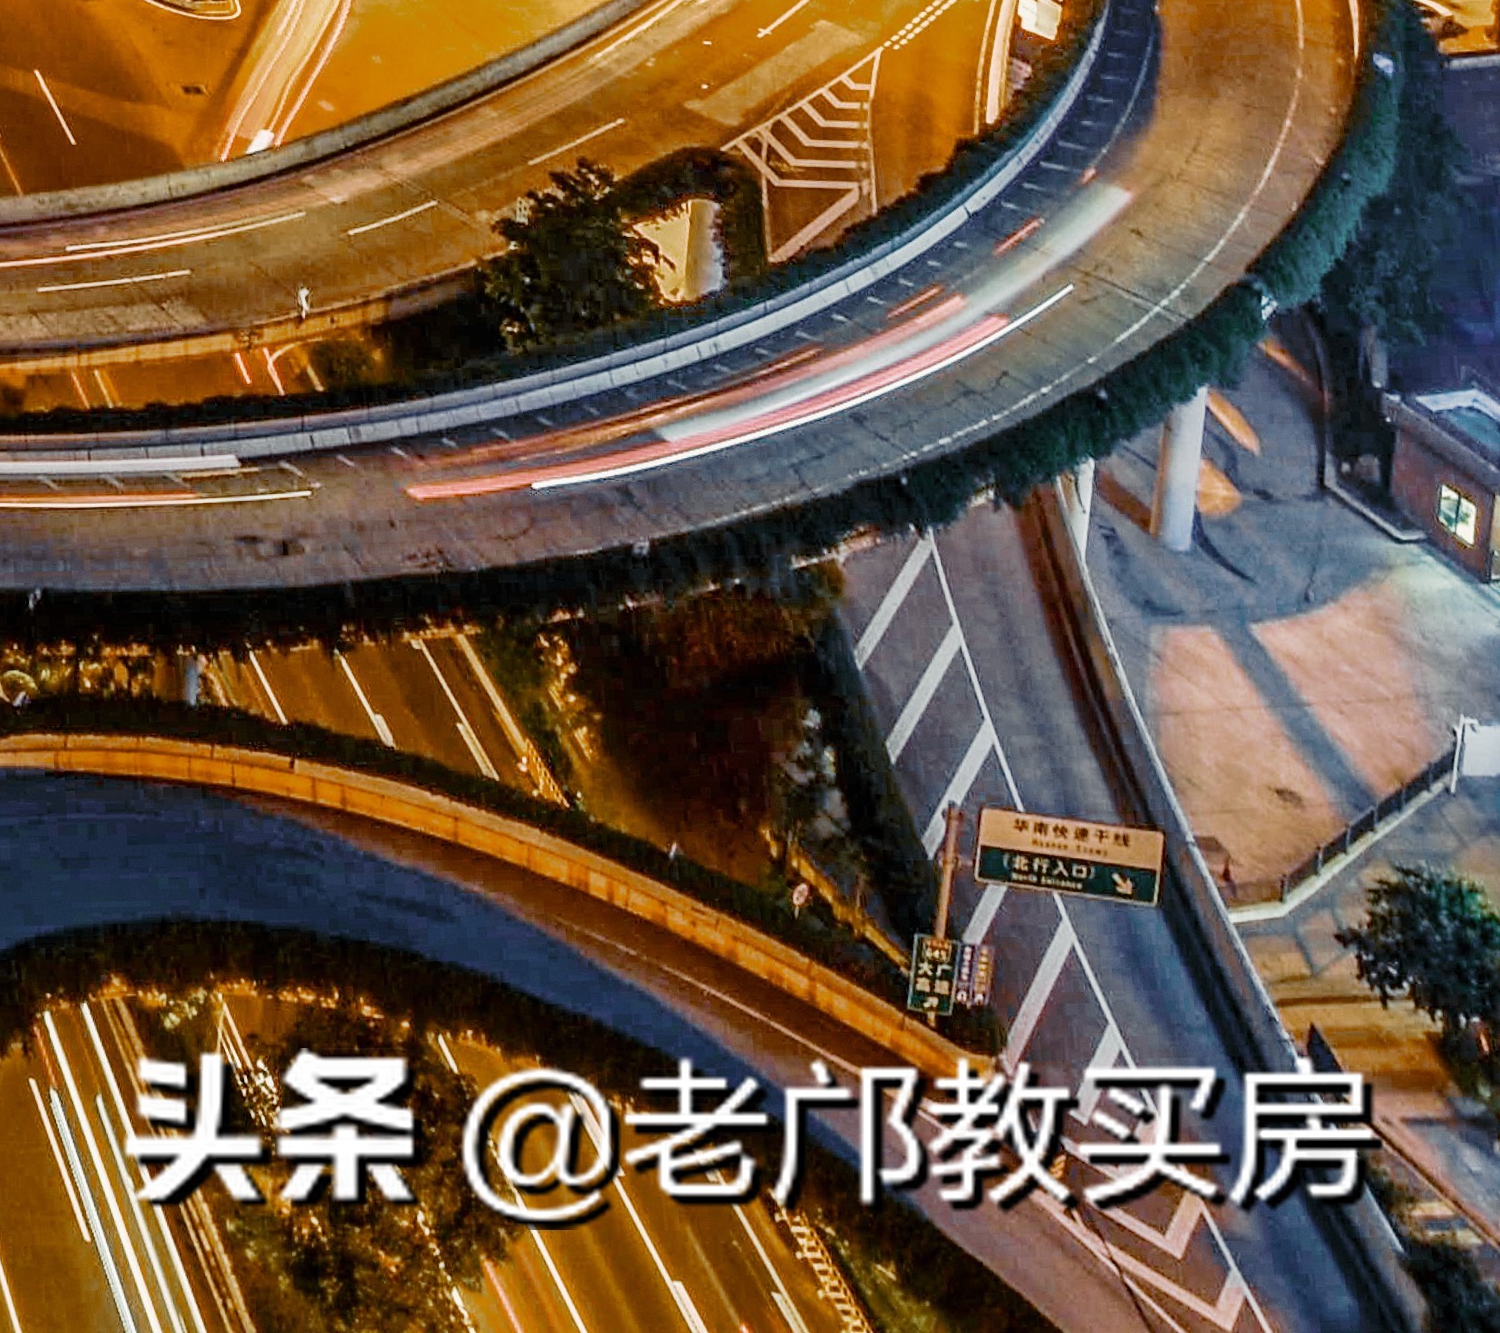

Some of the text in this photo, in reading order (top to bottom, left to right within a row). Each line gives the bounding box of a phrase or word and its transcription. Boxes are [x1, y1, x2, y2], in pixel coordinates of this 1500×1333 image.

[1014, 817, 1131, 848] 华南快速干线
